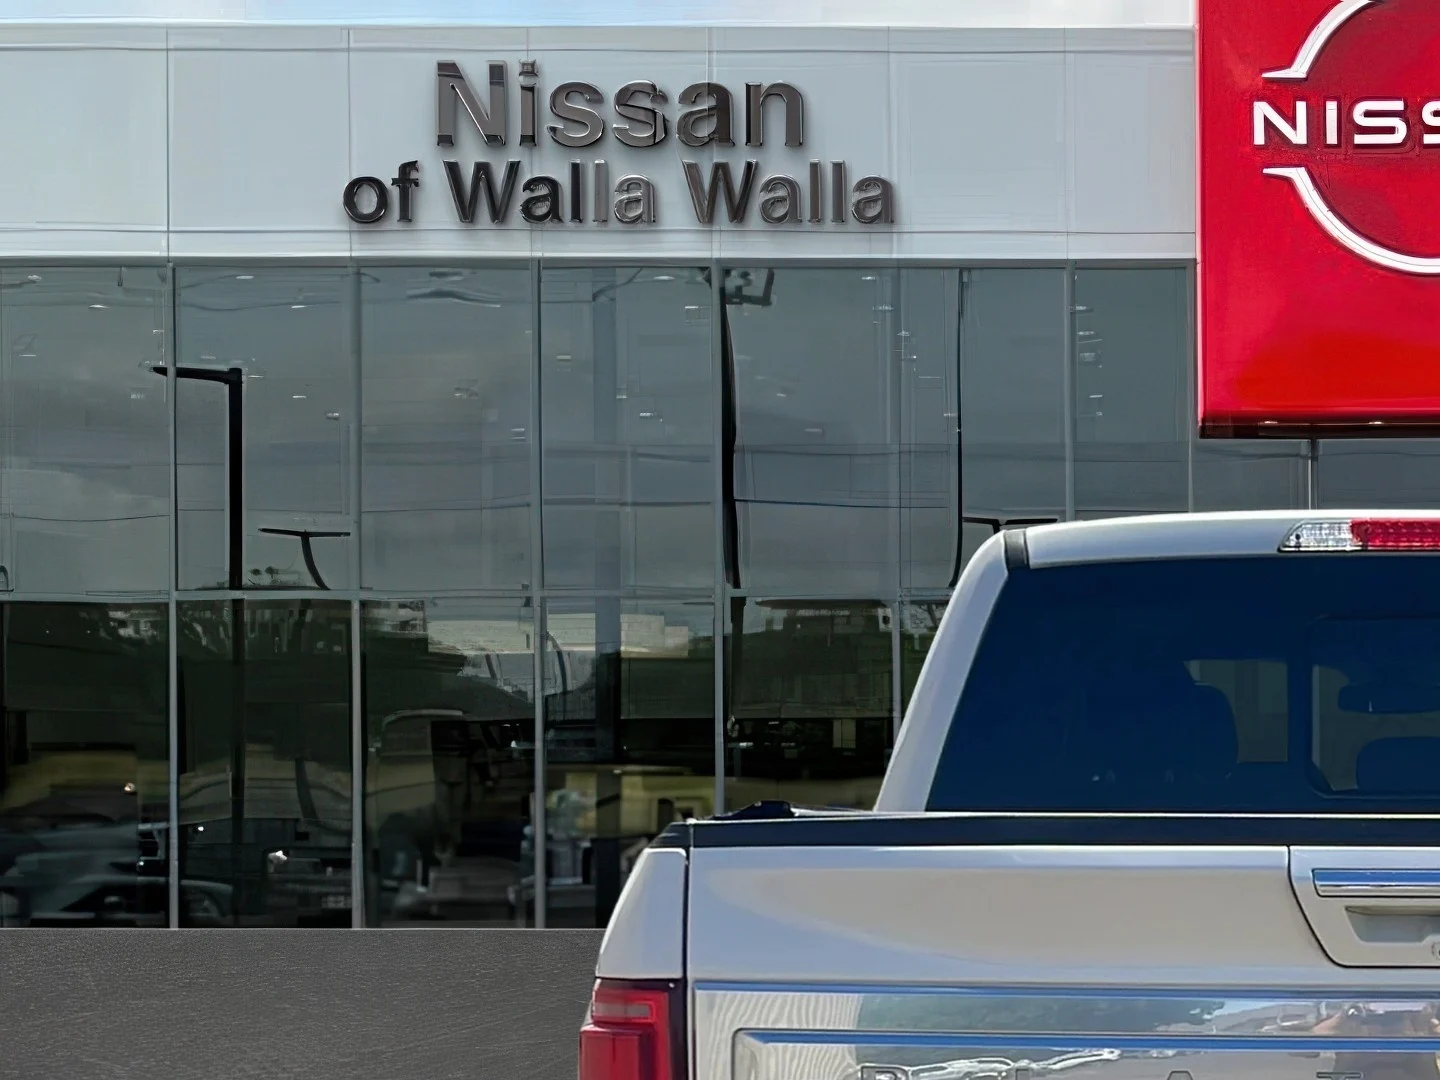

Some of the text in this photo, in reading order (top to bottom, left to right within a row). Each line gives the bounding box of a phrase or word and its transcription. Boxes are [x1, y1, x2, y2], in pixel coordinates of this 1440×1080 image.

[435, 59, 805, 147] Nissan
[341, 159, 896, 224] of Walla Walla
